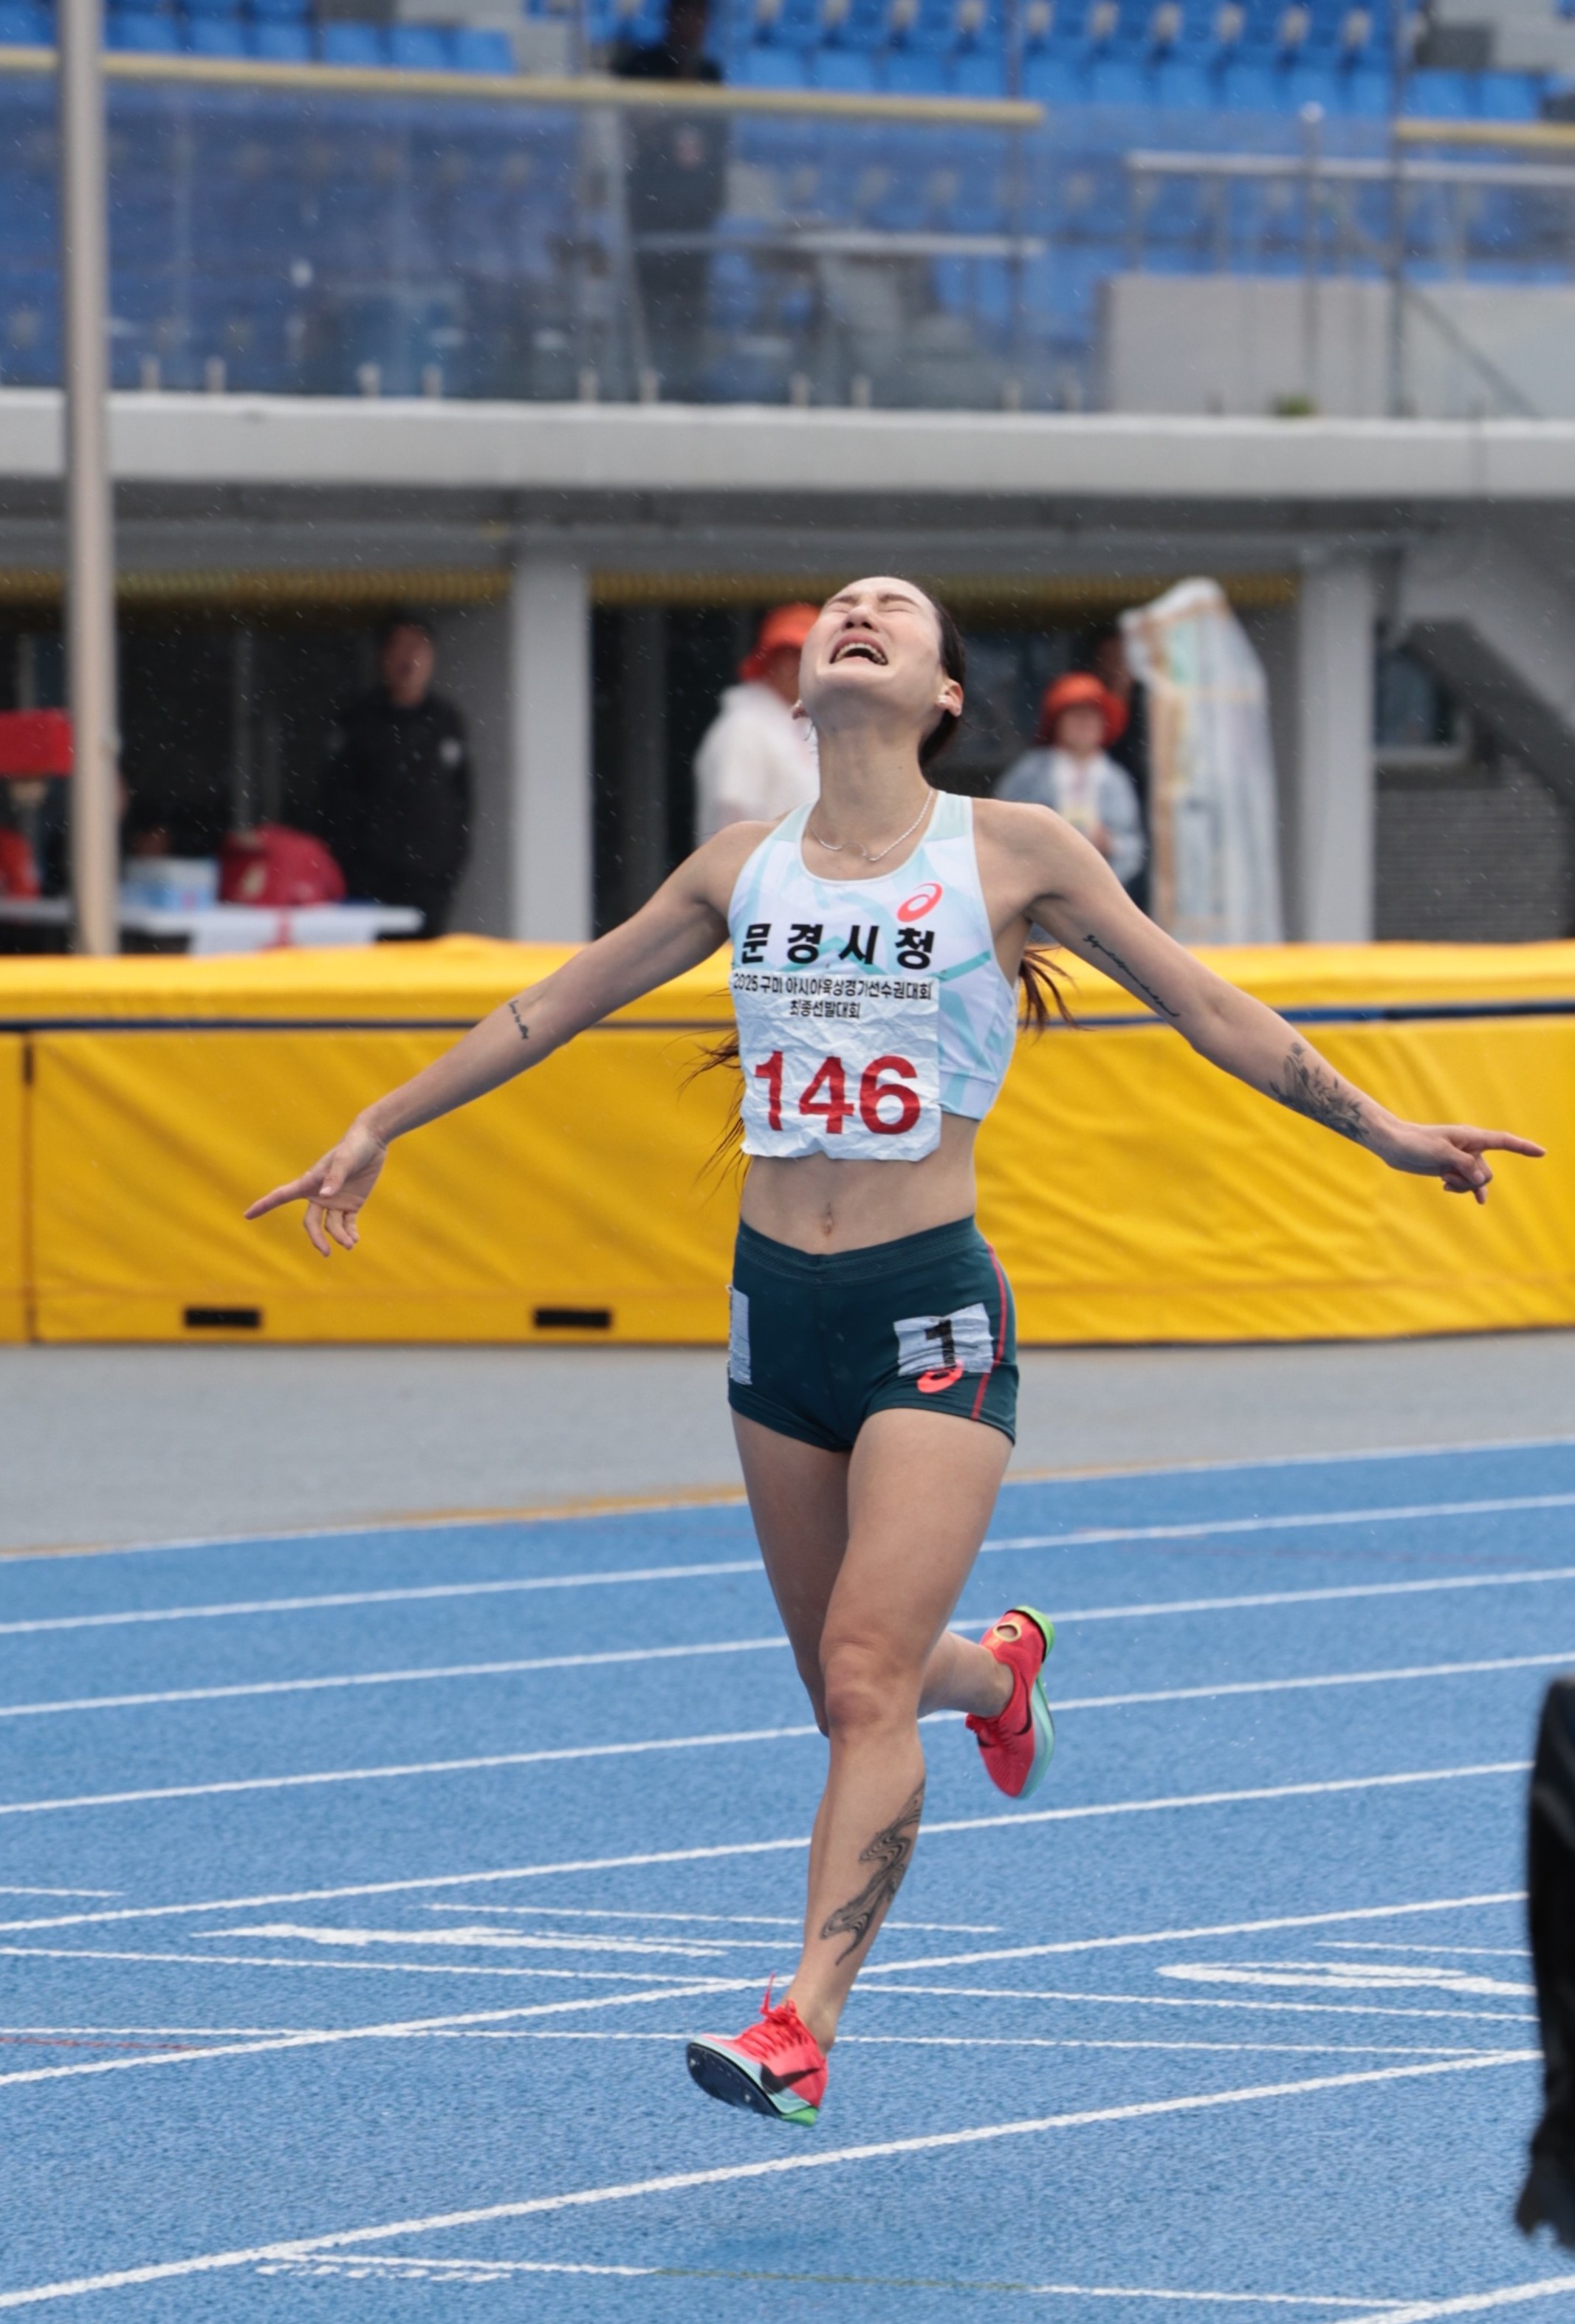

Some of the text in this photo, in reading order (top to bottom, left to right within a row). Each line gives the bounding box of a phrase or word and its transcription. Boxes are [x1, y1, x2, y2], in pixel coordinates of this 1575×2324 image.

[741, 924, 935, 970] 문경시청
[790, 999, 860, 1019] 최종선발대회
[755, 1051, 921, 1135] 146
[925, 1319, 955, 1366] 1
